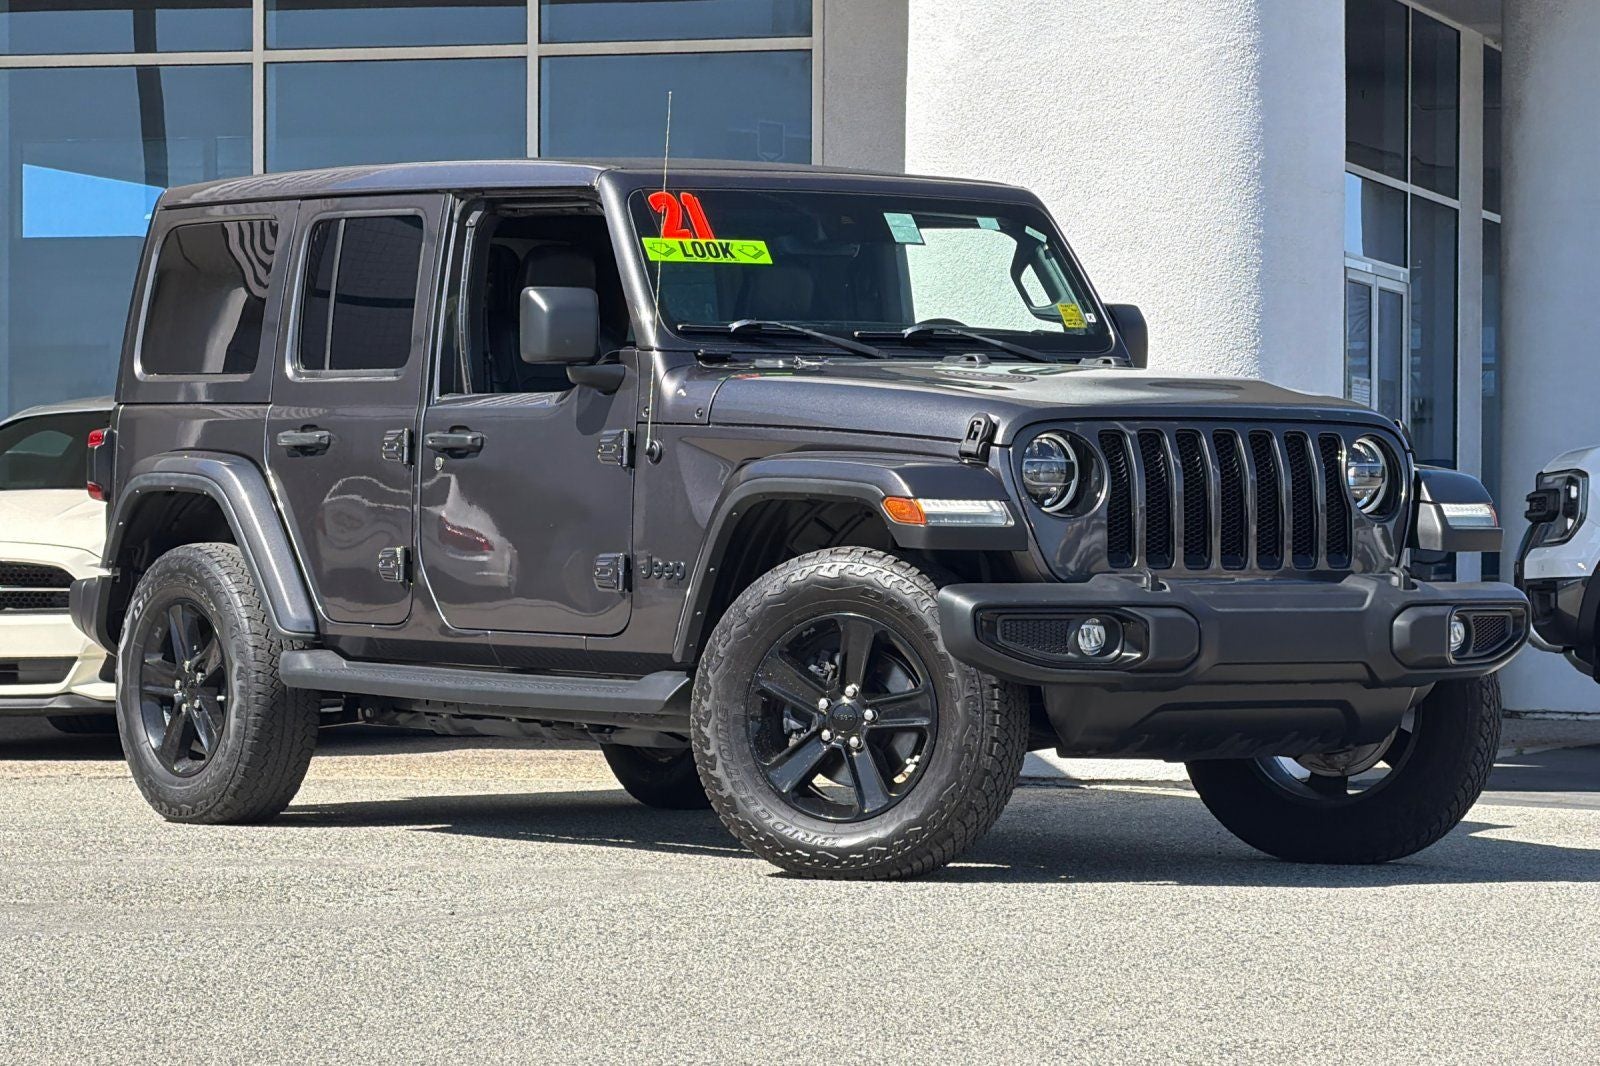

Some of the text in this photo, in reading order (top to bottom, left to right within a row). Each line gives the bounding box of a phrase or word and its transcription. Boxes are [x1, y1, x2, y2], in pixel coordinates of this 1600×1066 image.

[648, 191, 716, 239] 21
[677, 240, 738, 261] LOOK
[639, 553, 686, 586] Jeep
